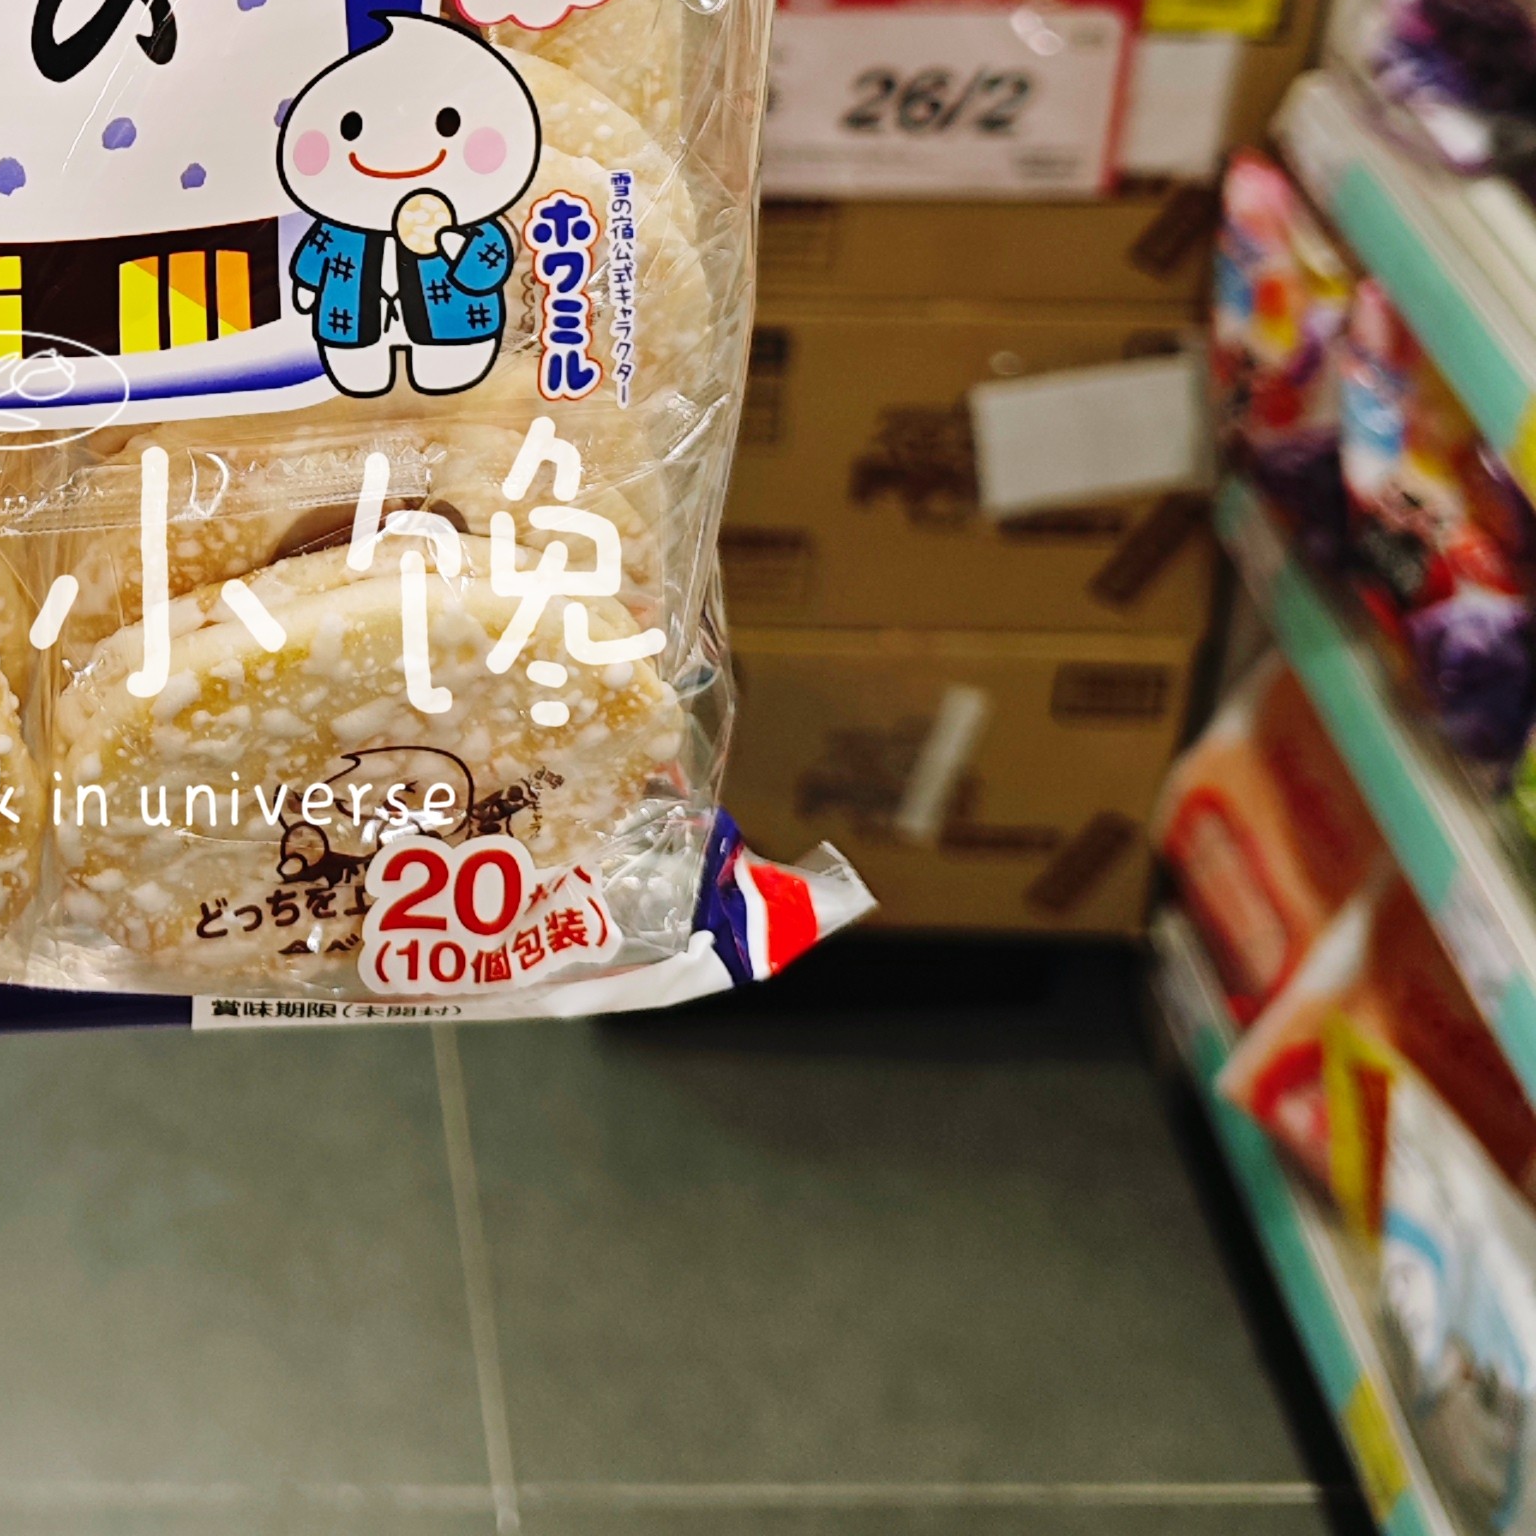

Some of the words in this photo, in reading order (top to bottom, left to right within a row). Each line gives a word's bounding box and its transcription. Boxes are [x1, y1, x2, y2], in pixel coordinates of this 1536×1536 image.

[840, 66, 1034, 136] 26/2
[532, 198, 595, 392] ホワミル
[609, 171, 635, 404] 雪の宿公式キャラクター
[374, 896, 610, 985] (10個包装)
